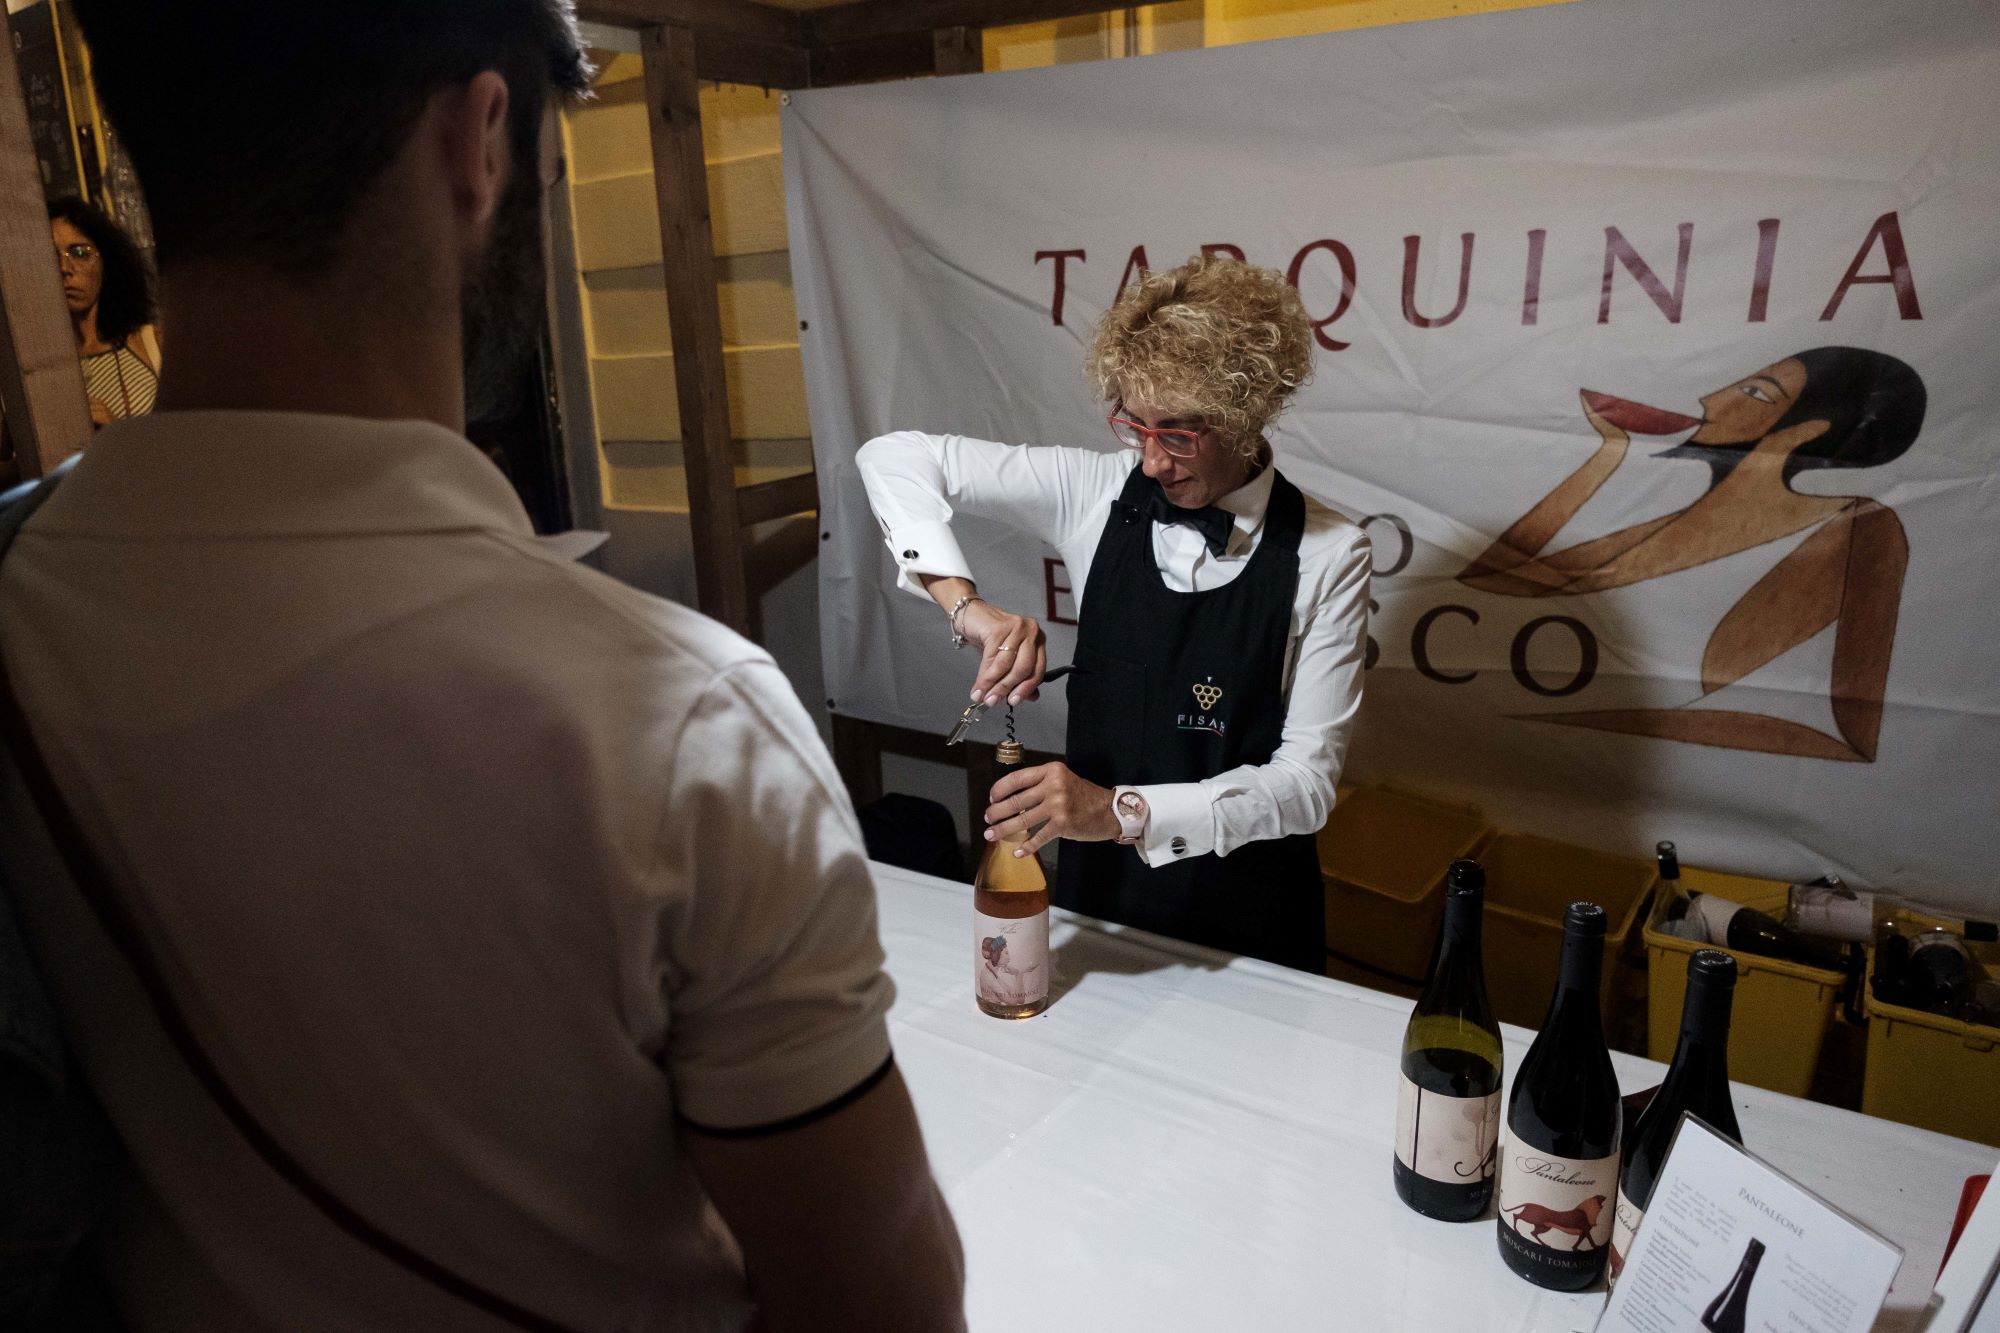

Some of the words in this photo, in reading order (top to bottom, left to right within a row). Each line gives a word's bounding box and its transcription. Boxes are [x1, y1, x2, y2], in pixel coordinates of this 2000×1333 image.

[1034, 210, 1923, 352] TAQUINIA
[1177, 713, 1226, 734] FISAR
[1515, 1154, 1598, 1186] Pantaleone
[1738, 1186, 1806, 1239] PANTALEONE
[1503, 1231, 1543, 1262] MUSCARI
